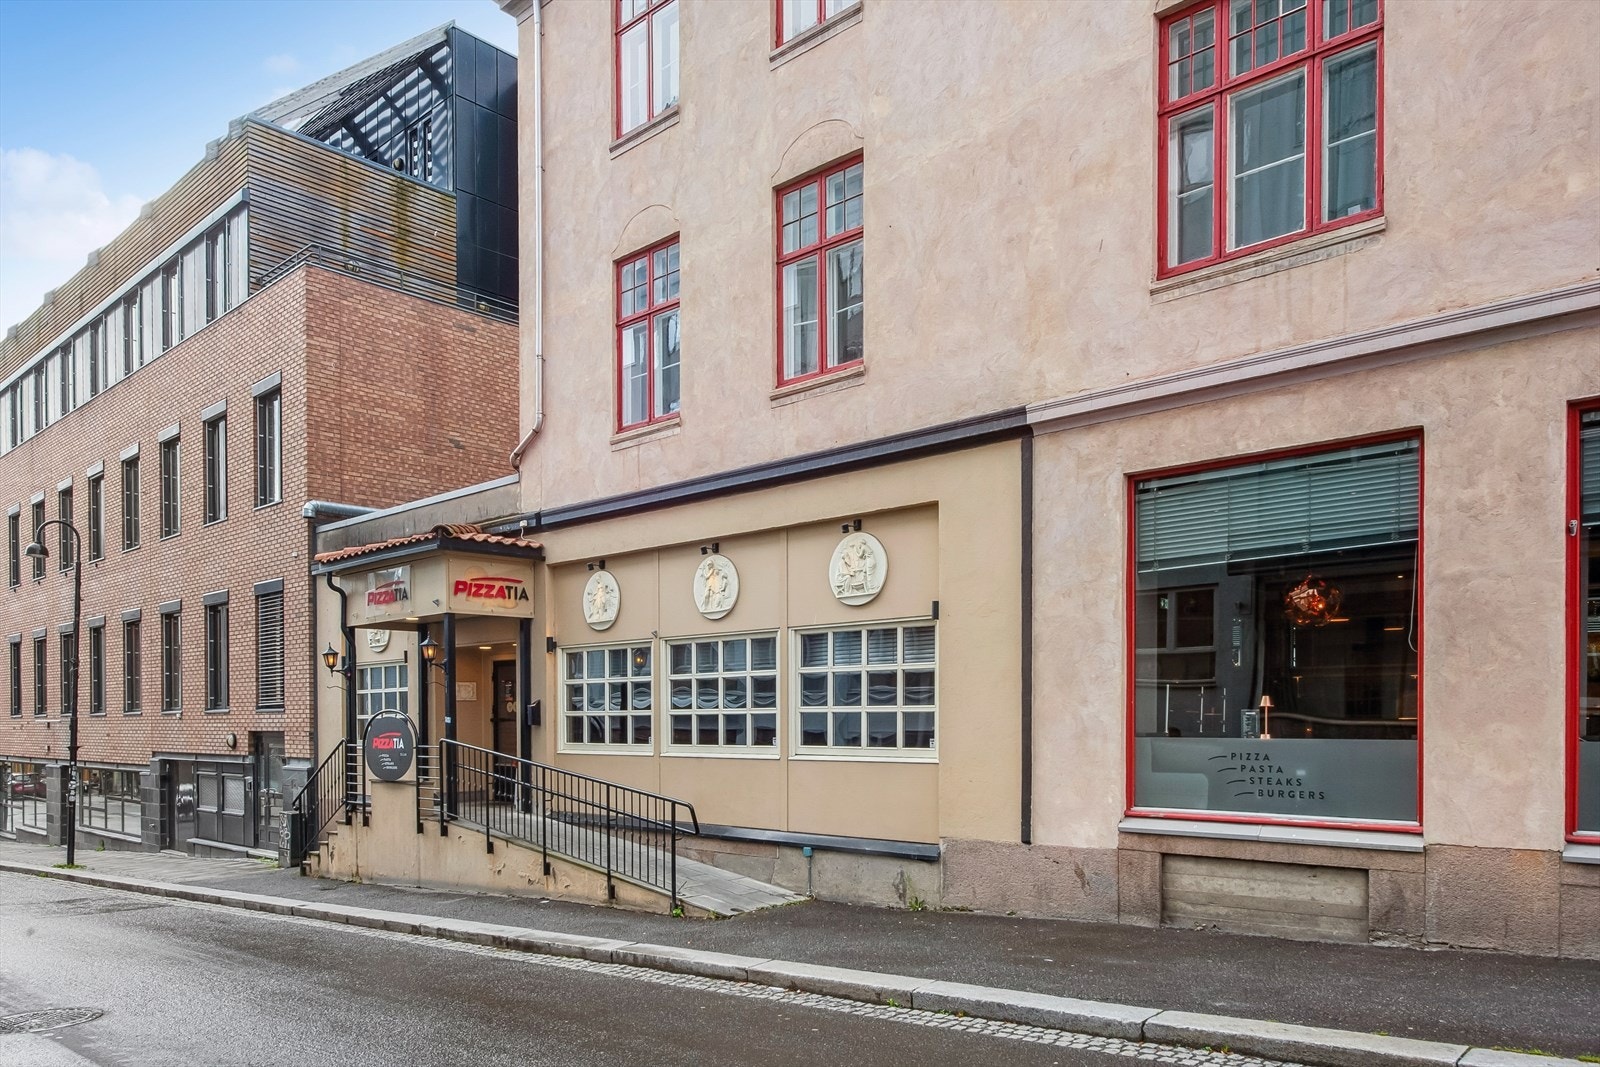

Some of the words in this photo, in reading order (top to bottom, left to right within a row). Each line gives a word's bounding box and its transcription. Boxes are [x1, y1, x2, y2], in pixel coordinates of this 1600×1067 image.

[453, 580, 529, 601] PIZZATIA
[367, 587, 409, 606] PIZZATIA
[372, 737, 405, 749] PIZZATIA
[1230, 752, 1270, 761] PIZZA
[1240, 764, 1283, 774] PASTA
[1249, 776, 1302, 787] STEAKS
[1257, 789, 1325, 800] BURGERS
